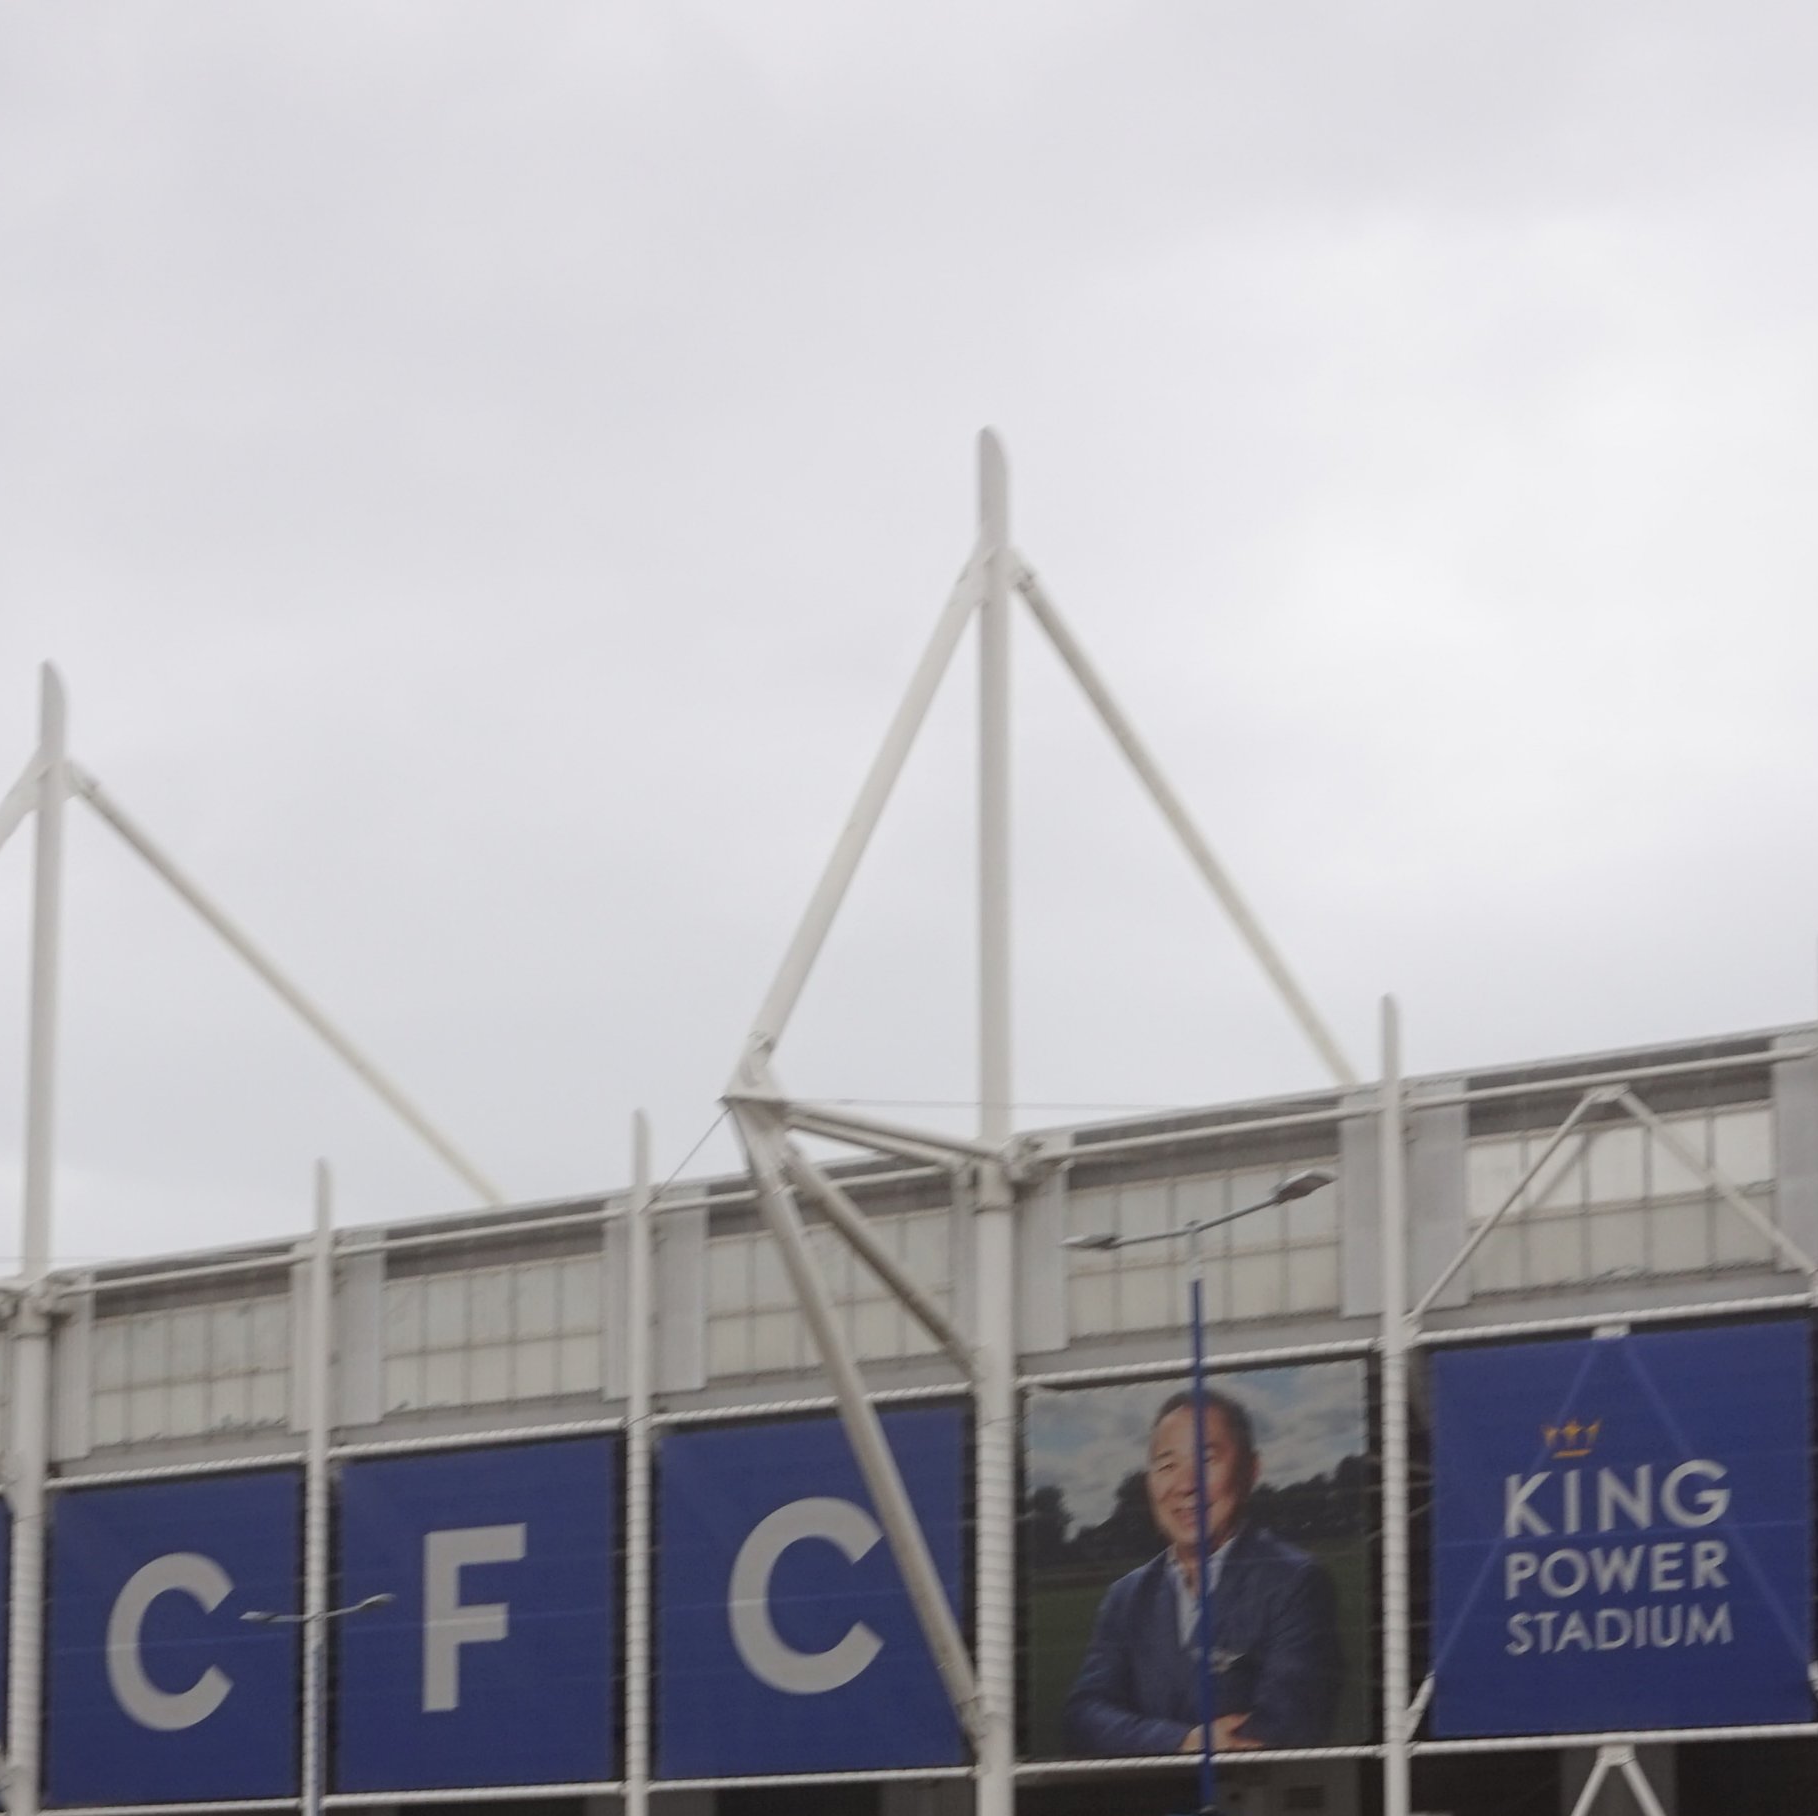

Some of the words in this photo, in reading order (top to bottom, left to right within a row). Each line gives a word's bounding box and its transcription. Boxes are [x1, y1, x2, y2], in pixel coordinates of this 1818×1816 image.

[1504, 1459, 1732, 1538] KING
[1505, 1540, 1730, 1600] POWER
[106, 1552, 234, 1732] C
[421, 1522, 527, 1713] F
[728, 1496, 885, 1696] C
[1506, 1602, 1733, 1656] STADIUM
